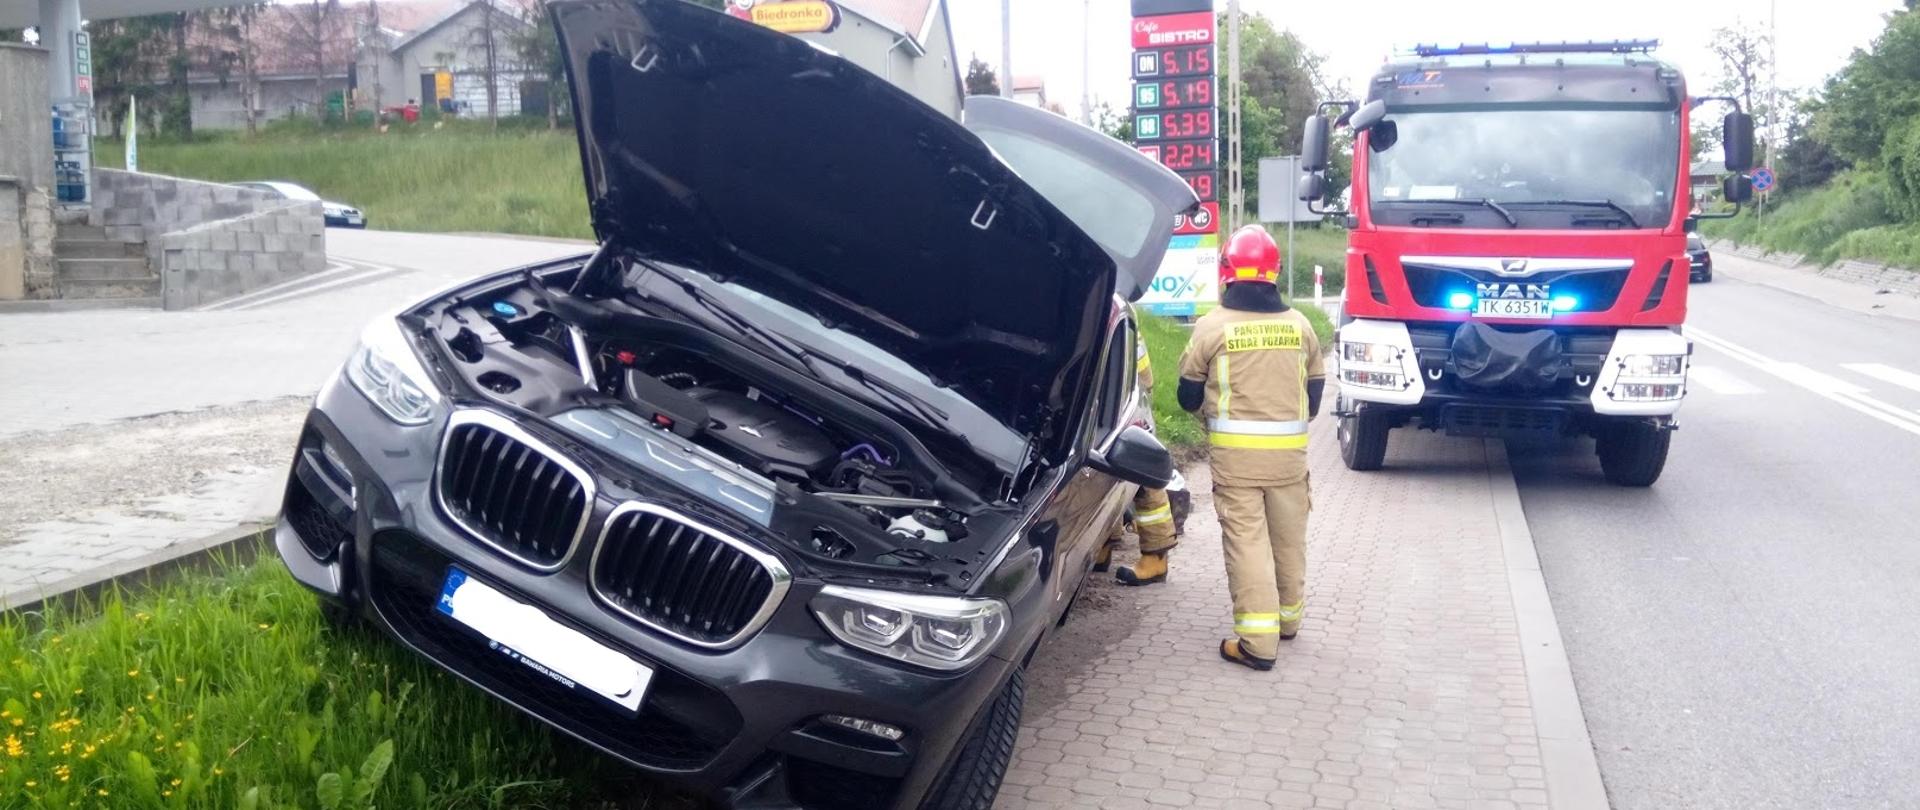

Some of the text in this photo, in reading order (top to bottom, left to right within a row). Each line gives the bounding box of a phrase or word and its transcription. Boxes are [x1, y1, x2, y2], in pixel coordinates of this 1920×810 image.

[756, 8, 823, 20] Biedronka
[1149, 29, 1210, 44] BISTRO
[1139, 48, 1210, 74] ON 5.15
[1164, 80, 1210, 106] 5.19
[1164, 111, 1211, 137] 5.39
[1165, 143, 1211, 168] 2.24
[1477, 284, 1550, 299] MAN
[1482, 300, 1550, 314] TK 6351W
[520, 656, 575, 689] BAWARIA MOTORS
